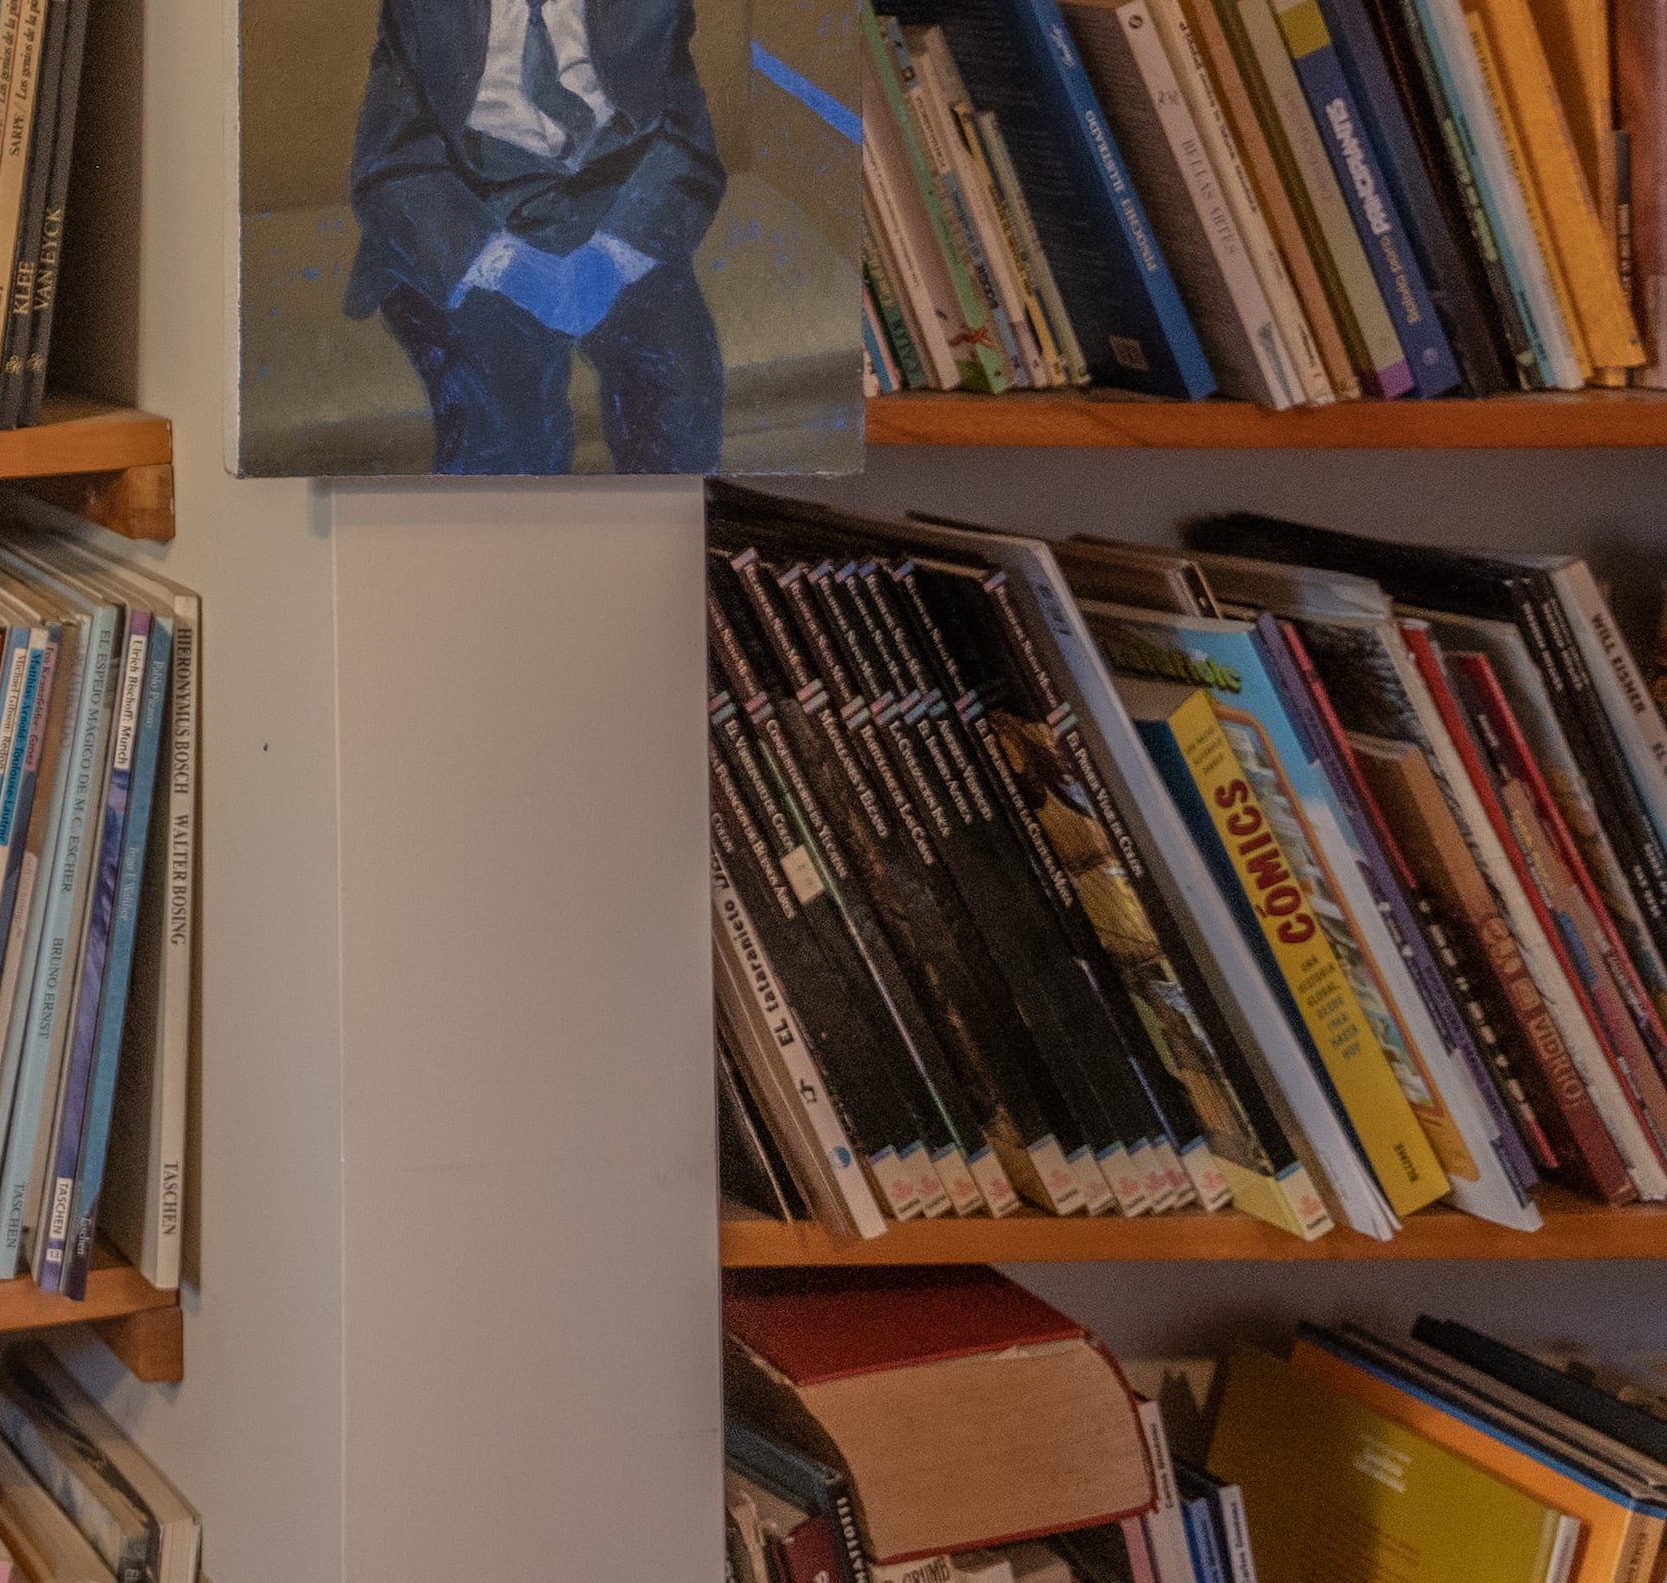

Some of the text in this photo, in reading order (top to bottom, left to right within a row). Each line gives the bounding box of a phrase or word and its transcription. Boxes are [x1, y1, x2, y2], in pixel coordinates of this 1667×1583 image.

[2, 31, 14, 45] de
[5, 18, 16, 29] la
[1323, 94, 1391, 239] PRINCIPIANTES
[8, 260, 40, 316] KLEE
[32, 207, 63, 311] VAN EYCK
[171, 627, 193, 794] HIERONYMUS BOSCH
[168, 813, 189, 945] WALTER BOSING
[1209, 772, 1316, 955] CÓMICS
[36, 936, 64, 1039] BRUNO ERNST
[718, 896, 797, 1048] EL tataranieto
[50, 1181, 69, 1234] TASCHEN
[156, 1160, 183, 1235] TASCHEN
